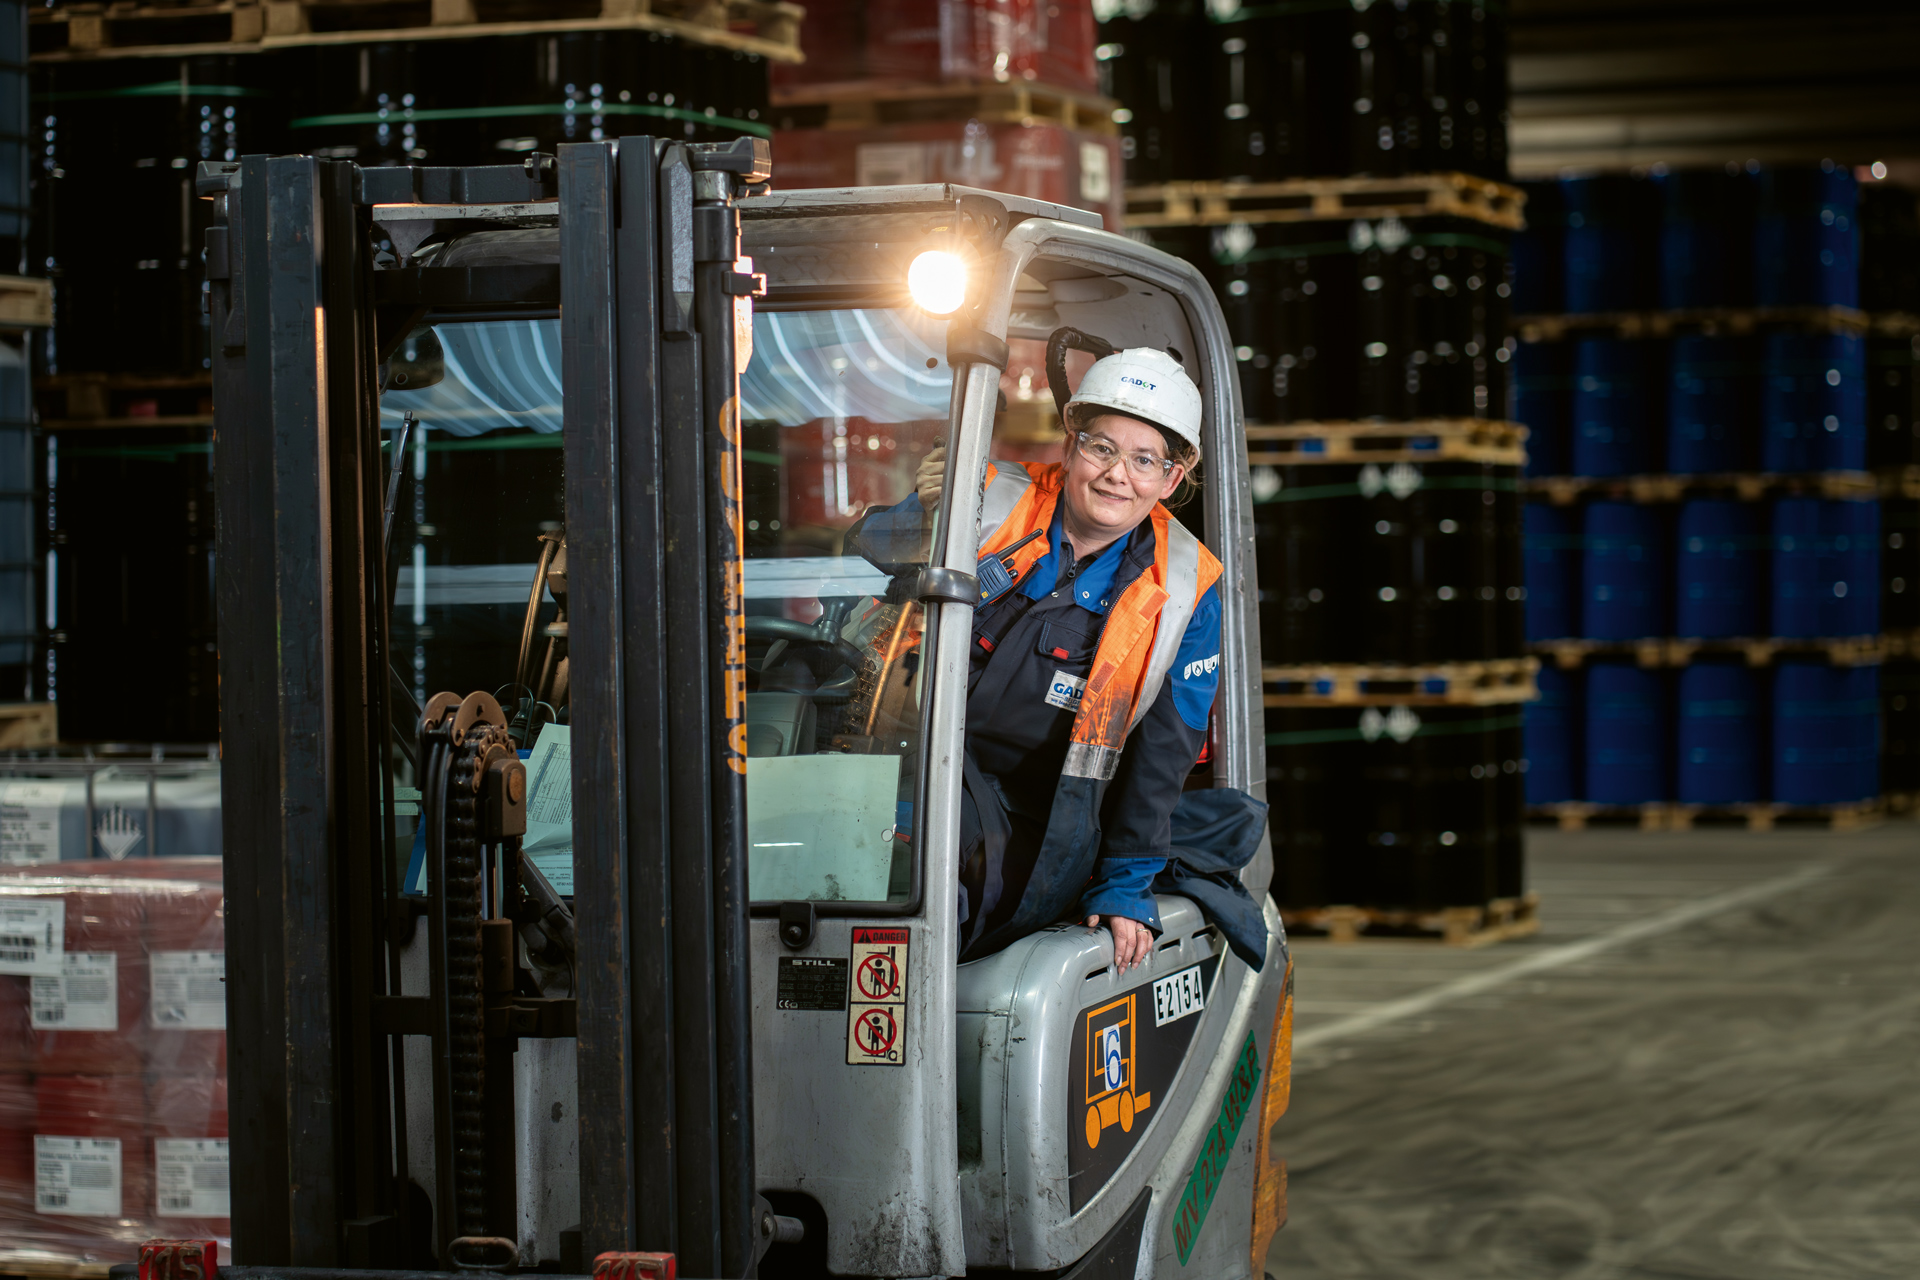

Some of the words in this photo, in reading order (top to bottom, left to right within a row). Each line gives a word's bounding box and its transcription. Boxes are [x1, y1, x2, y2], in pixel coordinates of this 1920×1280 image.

[1121, 376, 1156, 390] GADOT
[1053, 682, 1083, 699] GAD
[872, 931, 906, 942] DANGER
[1156, 971, 1201, 1020] E2154
[1105, 1029, 1122, 1090] 6
[1175, 1182, 1199, 1259] MV
[1201, 1123, 1226, 1200] 274
[1225, 1041, 1256, 1132] W&P
